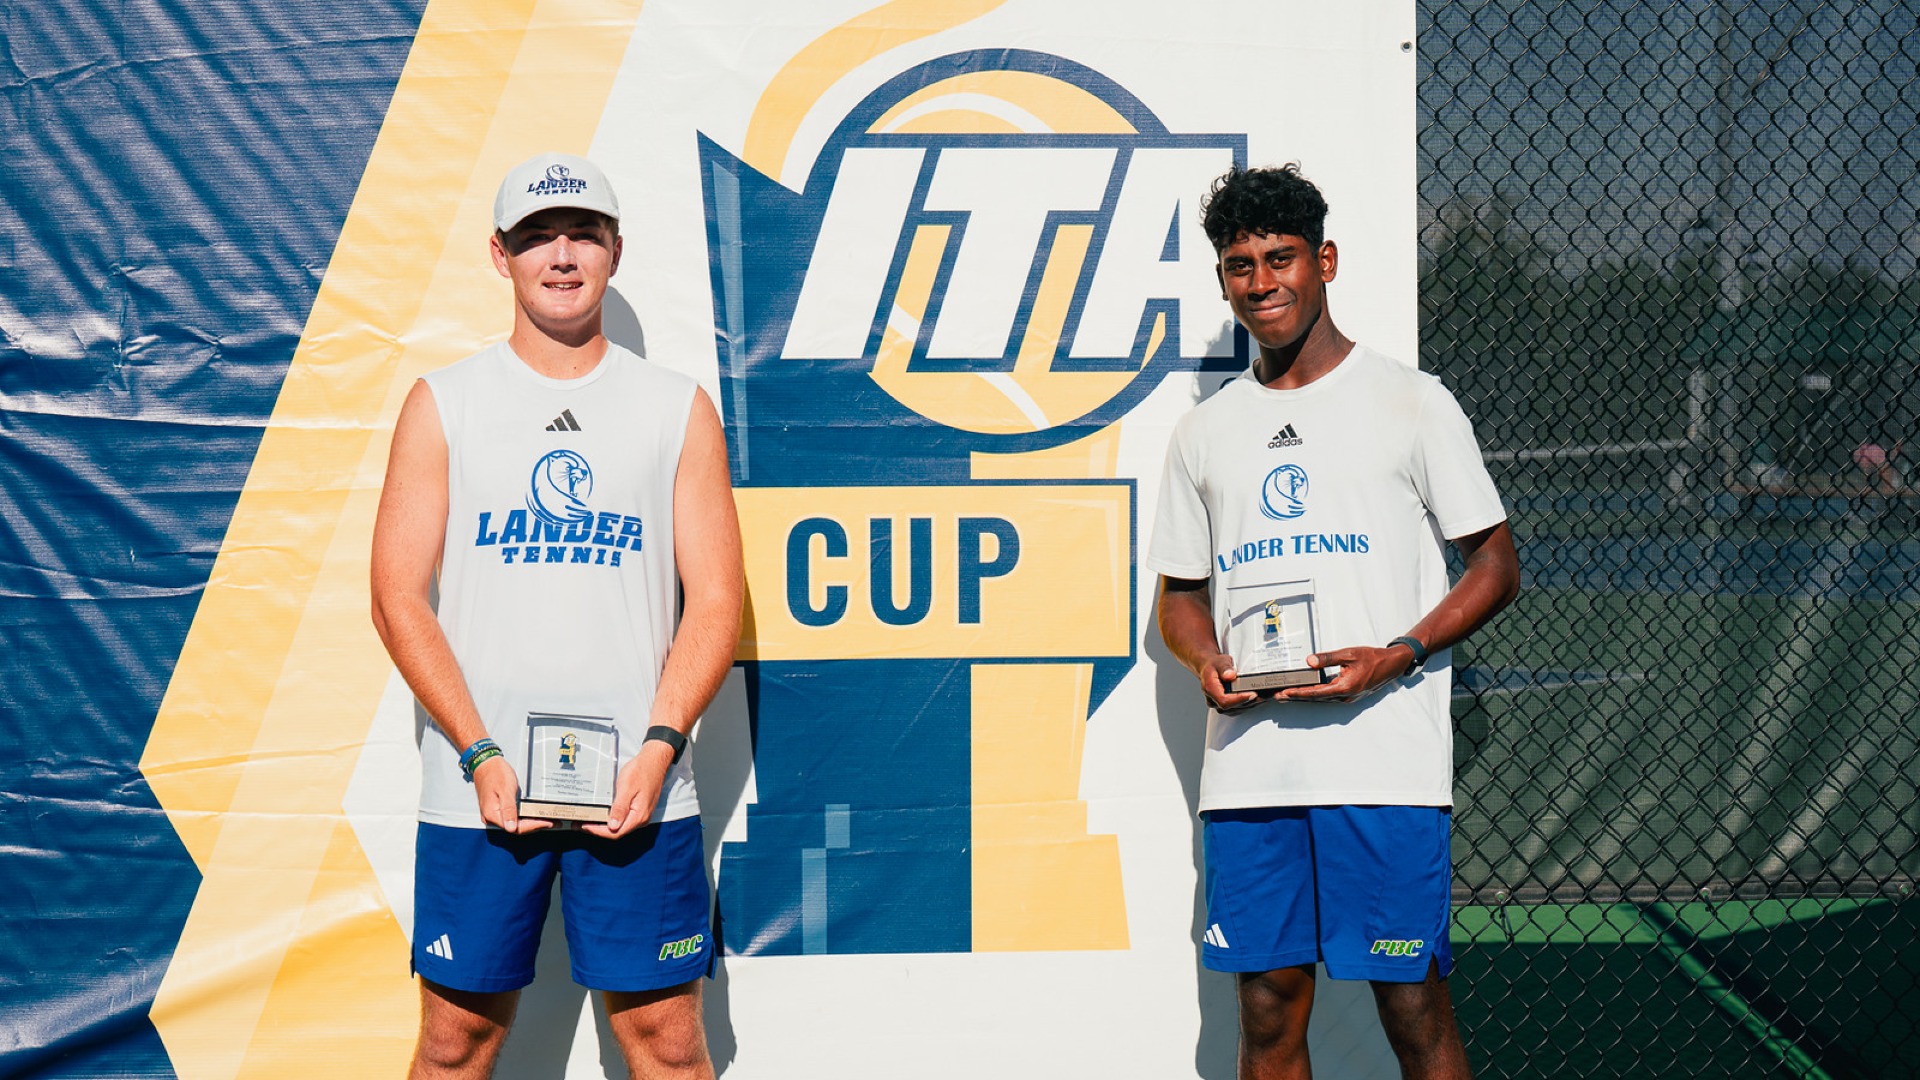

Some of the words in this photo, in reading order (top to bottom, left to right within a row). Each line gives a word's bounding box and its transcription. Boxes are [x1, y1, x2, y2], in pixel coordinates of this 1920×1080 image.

[527, 178, 587, 193] LANDER
[535, 187, 581, 196] TENNIS
[780, 147, 1235, 360] ITA
[1267, 436, 1304, 450] adidas
[475, 509, 643, 552] LANDER
[502, 546, 622, 568] TENNIS
[1217, 537, 1284, 573] LANDER
[1291, 533, 1370, 554] TENNIS
[786, 516, 1021, 627] CUP
[658, 933, 704, 961] PBC
[1370, 939, 1424, 957] PBC
